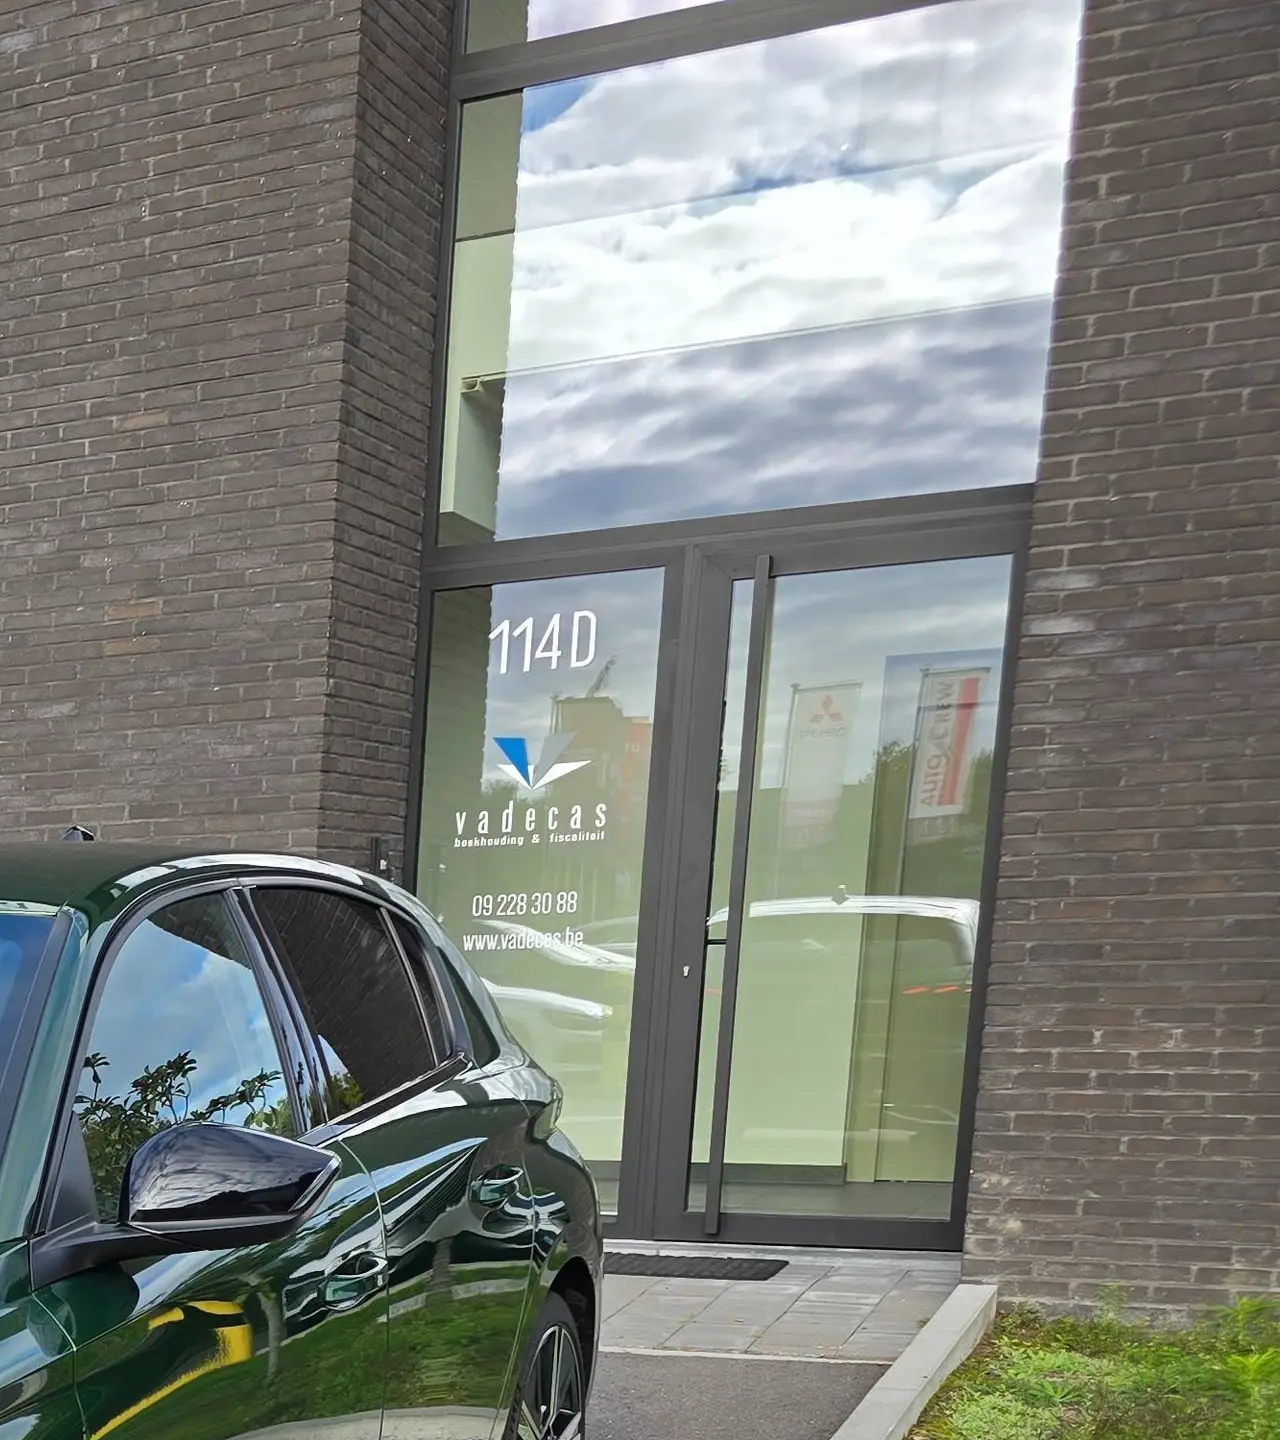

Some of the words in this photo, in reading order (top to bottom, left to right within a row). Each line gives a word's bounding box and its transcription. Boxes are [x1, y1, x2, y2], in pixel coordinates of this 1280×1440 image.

[489, 609, 597, 675] 114D
[455, 800, 607, 835] vadecas
[454, 834, 524, 847] boekhouding
[531, 834, 540, 843] &
[550, 830, 605, 843] fiscaliteit
[472, 895, 493, 917] 09
[496, 893, 527, 916] 228
[531, 892, 552, 914] 30
[556, 891, 578, 914] 88
[463, 926, 584, 951] www.vadecas.be
